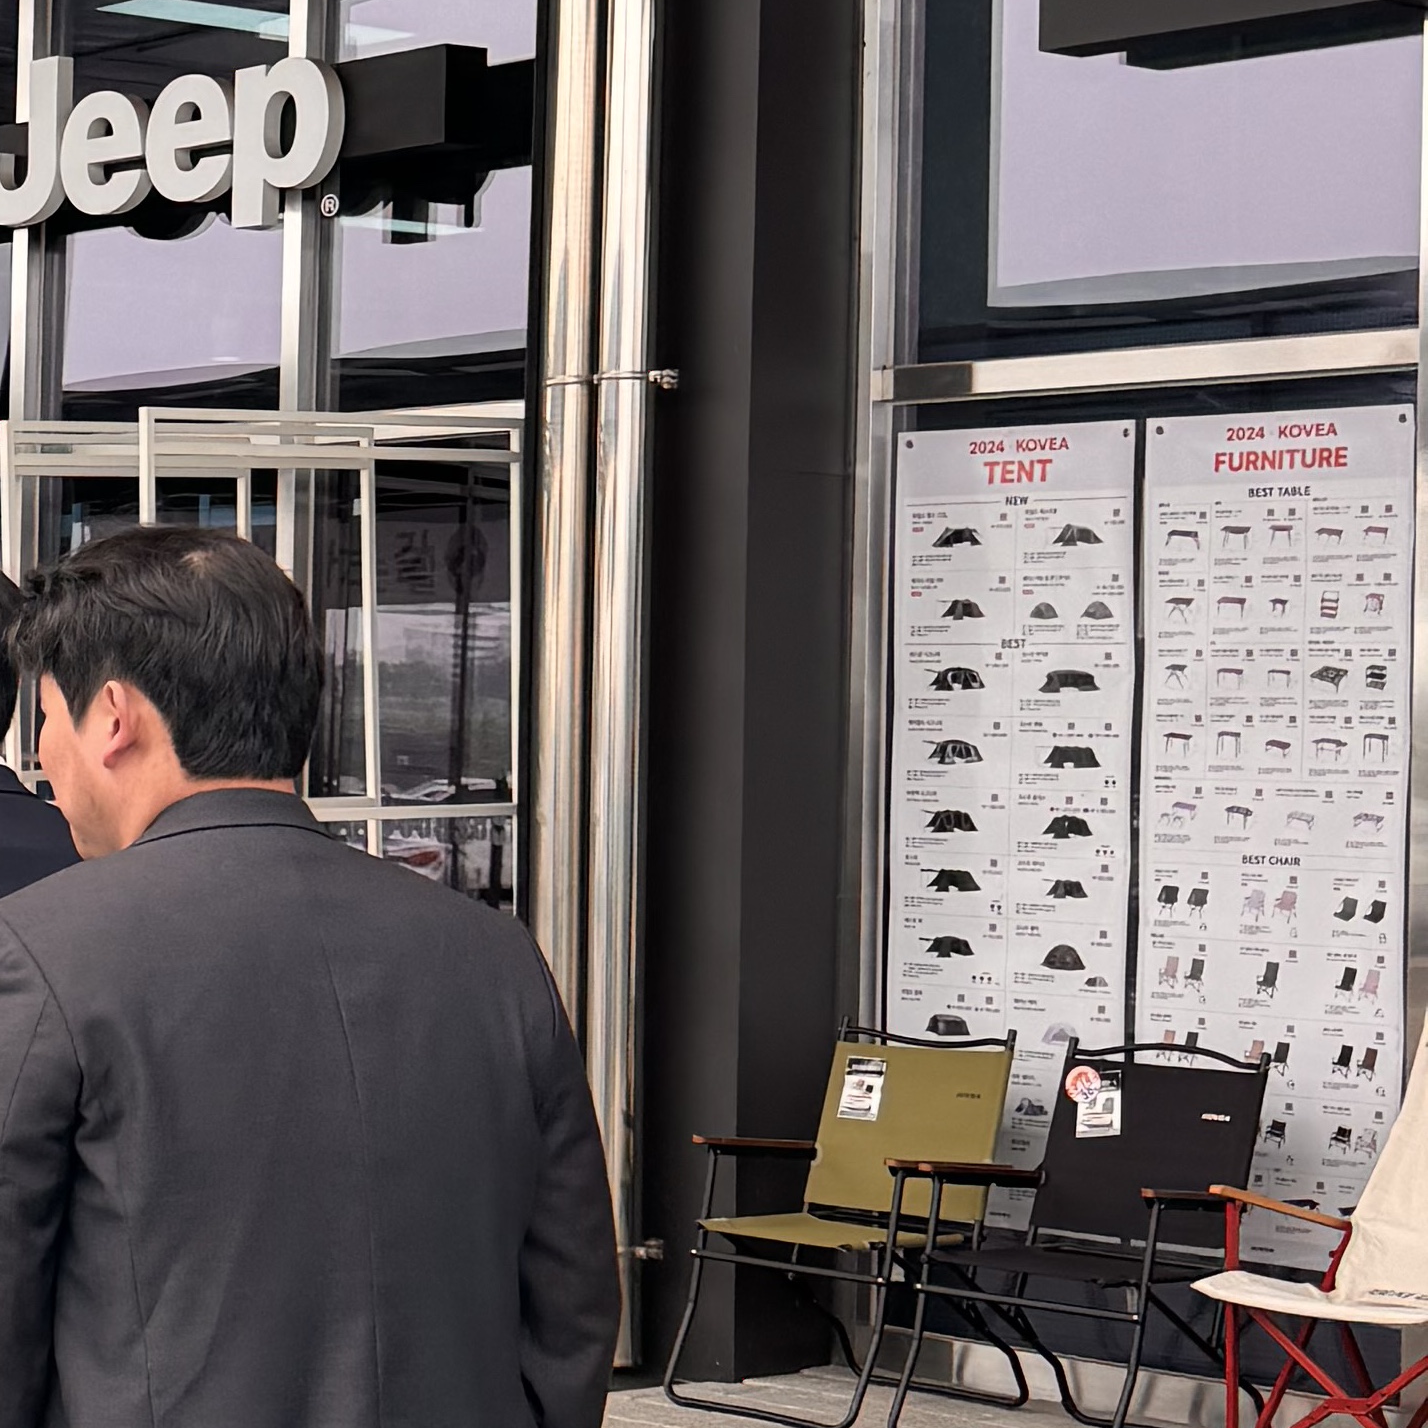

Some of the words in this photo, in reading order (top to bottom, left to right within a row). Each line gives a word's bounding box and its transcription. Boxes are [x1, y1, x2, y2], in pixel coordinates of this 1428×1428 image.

[1226, 426, 1266, 442] 2024
[1277, 422, 1338, 439] KOVEA
[969, 441, 1005, 455] 2024
[1016, 436, 1070, 453] KOVEA
[1213, 446, 1349, 473] FURNITURE
[983, 458, 1053, 486] TENT
[1248, 487, 1275, 498] BEST
[1278, 485, 1312, 497] TABLE
[1005, 495, 1029, 506] NEW
[1001, 638, 1026, 649] BEST
[1241, 854, 1266, 865] BEST
[1268, 855, 1301, 867] CHAIR
